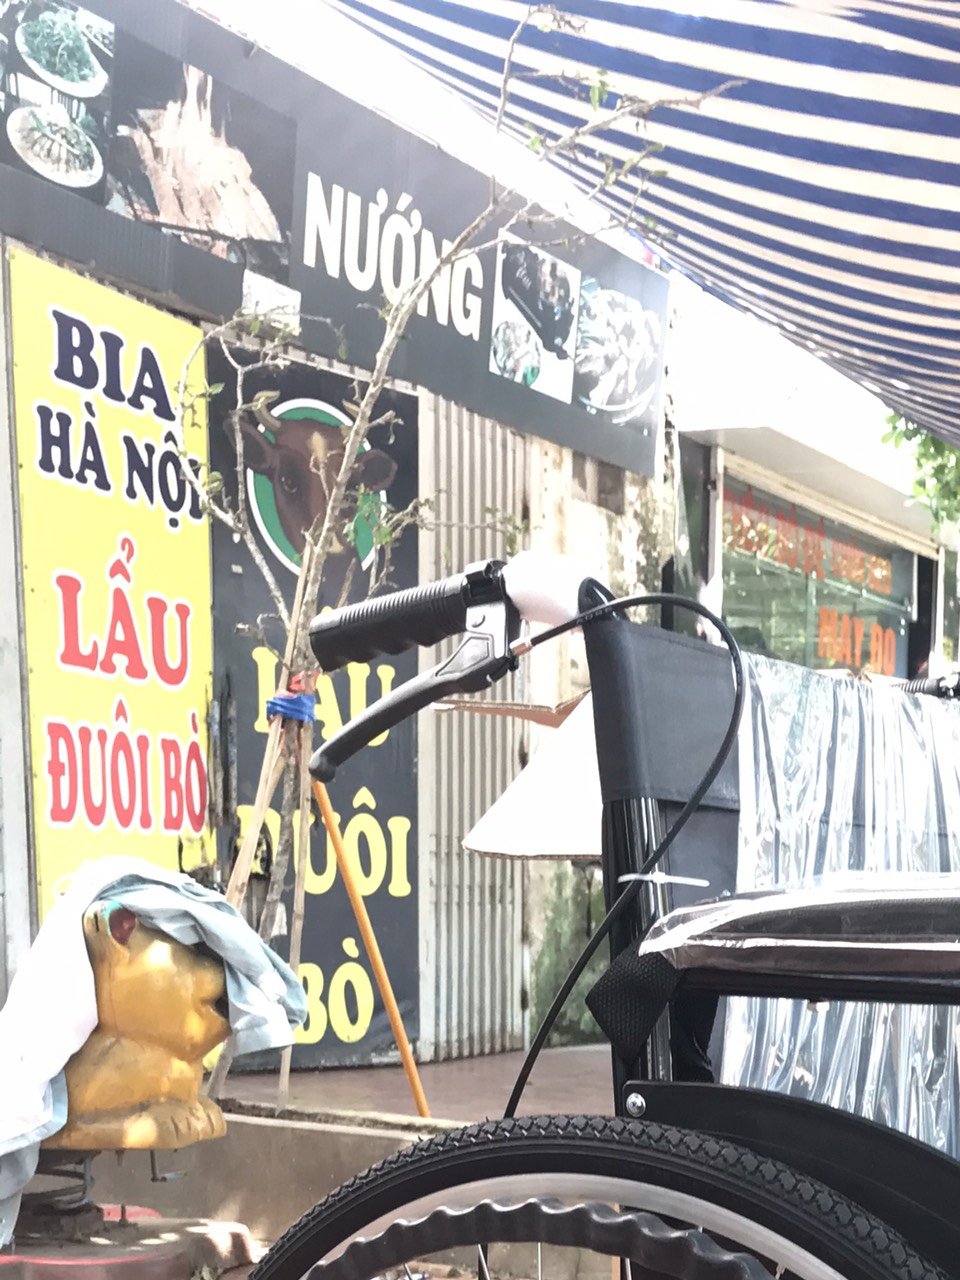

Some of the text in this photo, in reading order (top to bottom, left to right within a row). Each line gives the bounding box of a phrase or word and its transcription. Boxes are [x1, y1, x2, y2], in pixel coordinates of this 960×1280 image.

[303, 171, 484, 342] NƯỚNG
[52, 310, 176, 421] BIA
[36, 401, 111, 491] HÀ
[56, 537, 190, 685] LẨU
[47, 699, 207, 832] ĐUÔI BÒ
[293, 937, 375, 1045] BÒ
